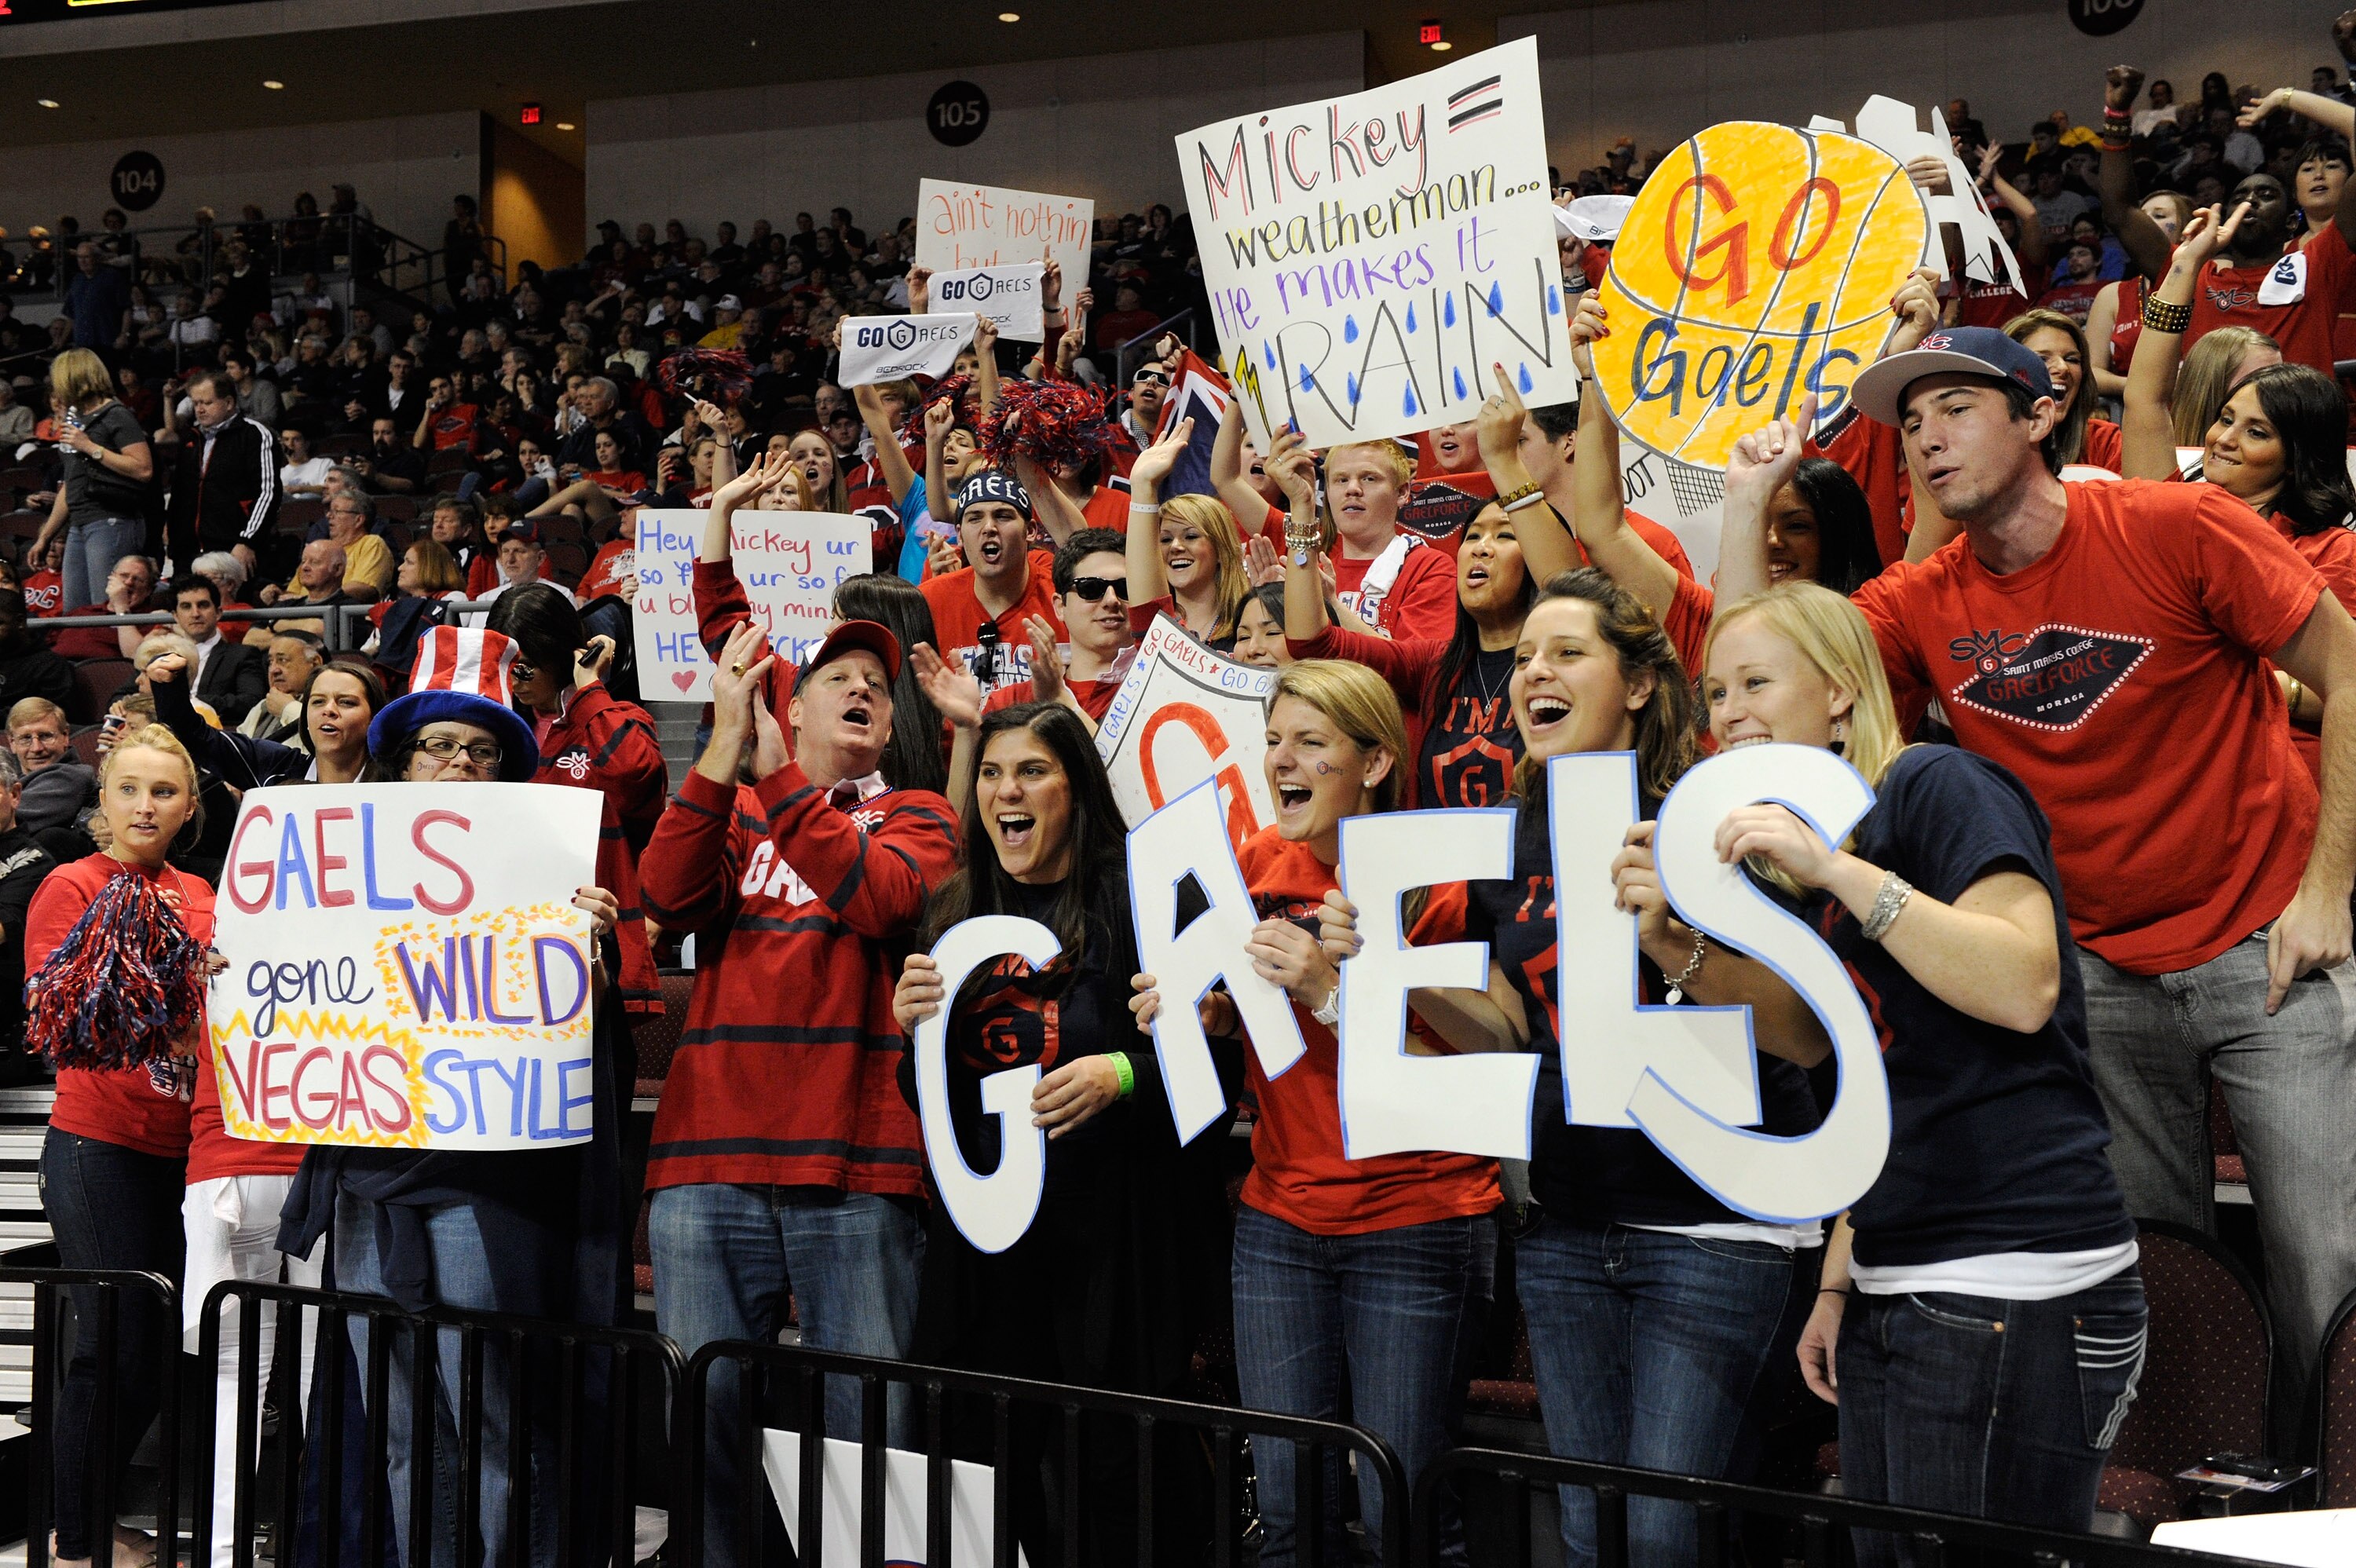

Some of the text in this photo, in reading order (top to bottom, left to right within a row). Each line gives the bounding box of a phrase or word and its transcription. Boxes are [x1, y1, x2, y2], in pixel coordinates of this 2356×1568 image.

[936, 101, 981, 127] 105
[1198, 103, 1428, 221] Mickey
[116, 169, 157, 195] 104
[927, 188, 1088, 251] ain't nothin
[942, 280, 965, 301] GO
[1215, 216, 1498, 339] He makes it
[858, 327, 884, 348] GO
[1276, 257, 1553, 436] RAIN
[1630, 302, 1861, 422] Gaels
[958, 476, 1030, 509] GAELS
[639, 519, 696, 572] Hey
[826, 540, 859, 556] ur
[640, 568, 664, 586] so
[749, 572, 786, 587] ur
[798, 575, 825, 590] so
[639, 598, 657, 614] u
[784, 598, 829, 620] min
[655, 631, 712, 663] HE
[1143, 628, 1162, 656] GO
[1948, 628, 2027, 667] SMC
[1221, 667, 1249, 689] GO
[1987, 647, 2116, 702] GAELFORCE
[2003, 663, 2031, 676] SAINT
[2036, 692, 2085, 713] MORAGA
[1460, 765, 1487, 808] G
[226, 802, 475, 916] GAELS
[247, 932, 592, 1039] gone WILD
[982, 1017, 1021, 1064] G
[221, 1039, 593, 1140] VEGAS STYLE
